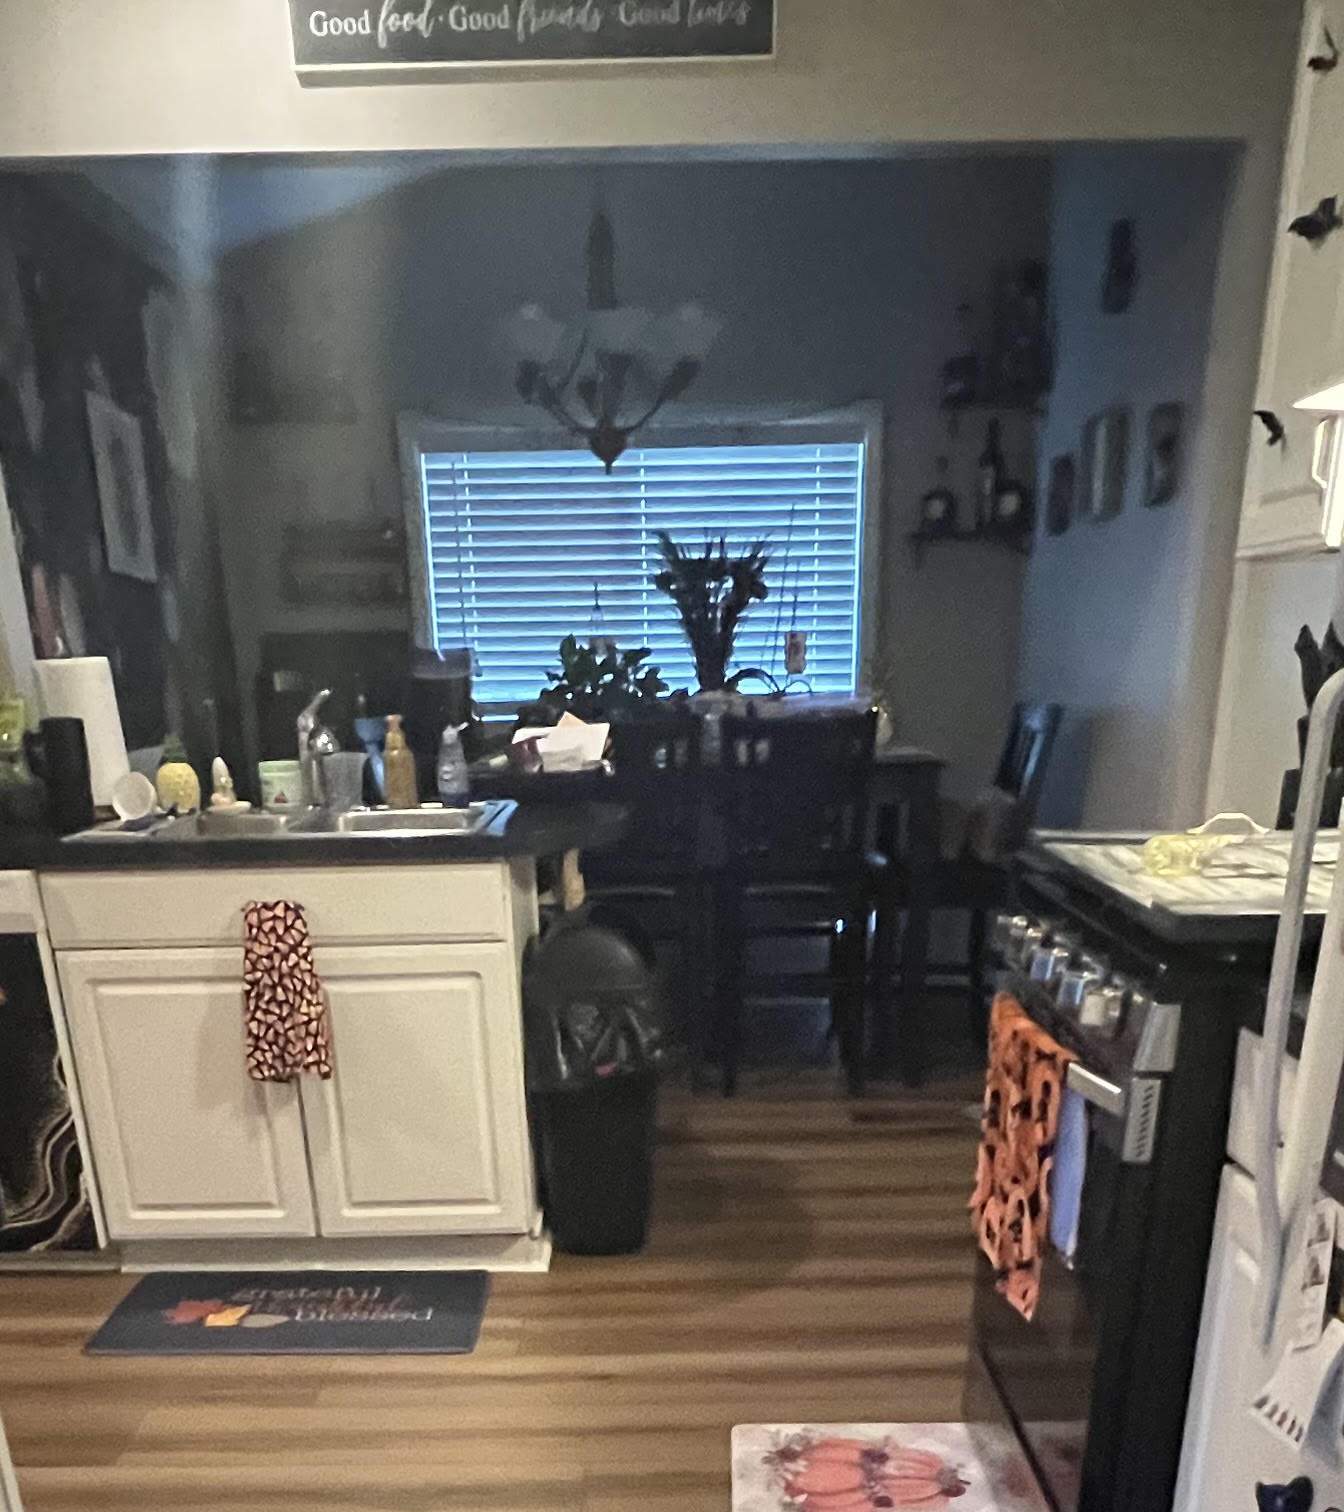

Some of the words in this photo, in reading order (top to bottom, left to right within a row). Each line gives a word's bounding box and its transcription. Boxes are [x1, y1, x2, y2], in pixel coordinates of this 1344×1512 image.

[309, 8, 372, 37] Good
[377, 0, 435, 49] food
[448, 3, 510, 32] Good
[619, 0, 681, 27] Good
[294, 1306, 434, 1322] blessed
